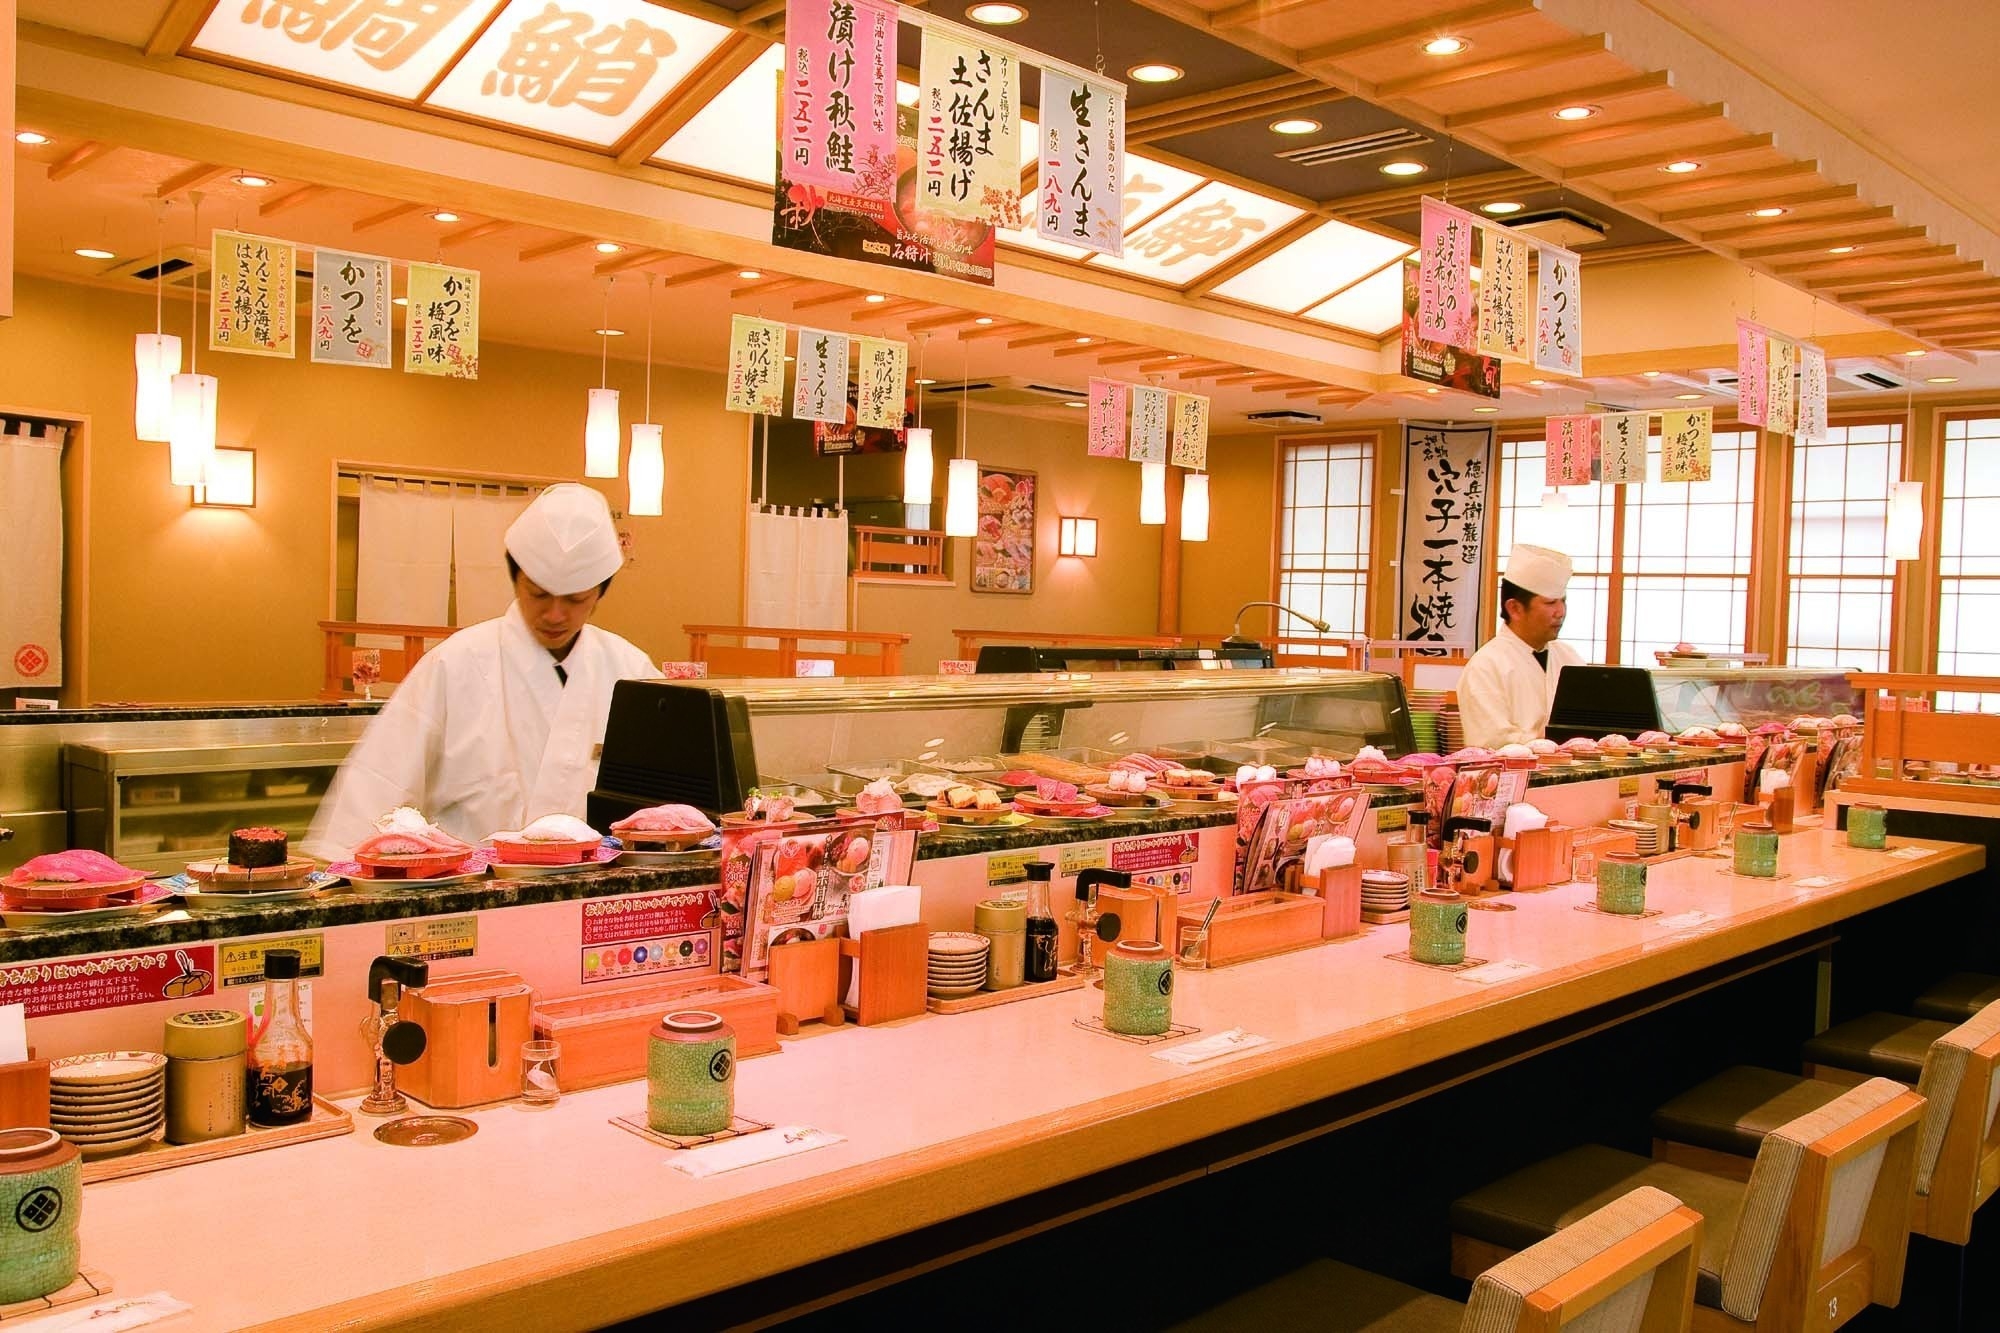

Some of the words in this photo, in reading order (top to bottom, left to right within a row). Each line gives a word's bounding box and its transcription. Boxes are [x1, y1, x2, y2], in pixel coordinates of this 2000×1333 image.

[826, 0, 857, 174] 漬け秋鮭
[973, 49, 995, 156] さんま
[948, 56, 975, 201] 土佐揚げ
[1070, 81, 1092, 238] 生さんま
[234, 243, 253, 332] はさみ揚げ
[892, 243, 931, 265] 石狩汁
[254, 244, 271, 346] れんこん海鮮
[340, 261, 365, 344] かつを
[427, 301, 446, 364] 梅風味
[443, 276, 462, 342] かつを
[1553, 259, 1567, 350] かつを
[744, 330, 761, 406] 照り焼き
[758, 328, 771, 384] さんま
[814, 335, 829, 416] 生さんま
[872, 350, 885, 421] 照り焼き
[884, 347, 895, 401] さんま
[1617, 415, 1630, 480] 生さんま
[1686, 413, 1700, 458] かつを
[1828, 1296, 1838, 1320] 13
